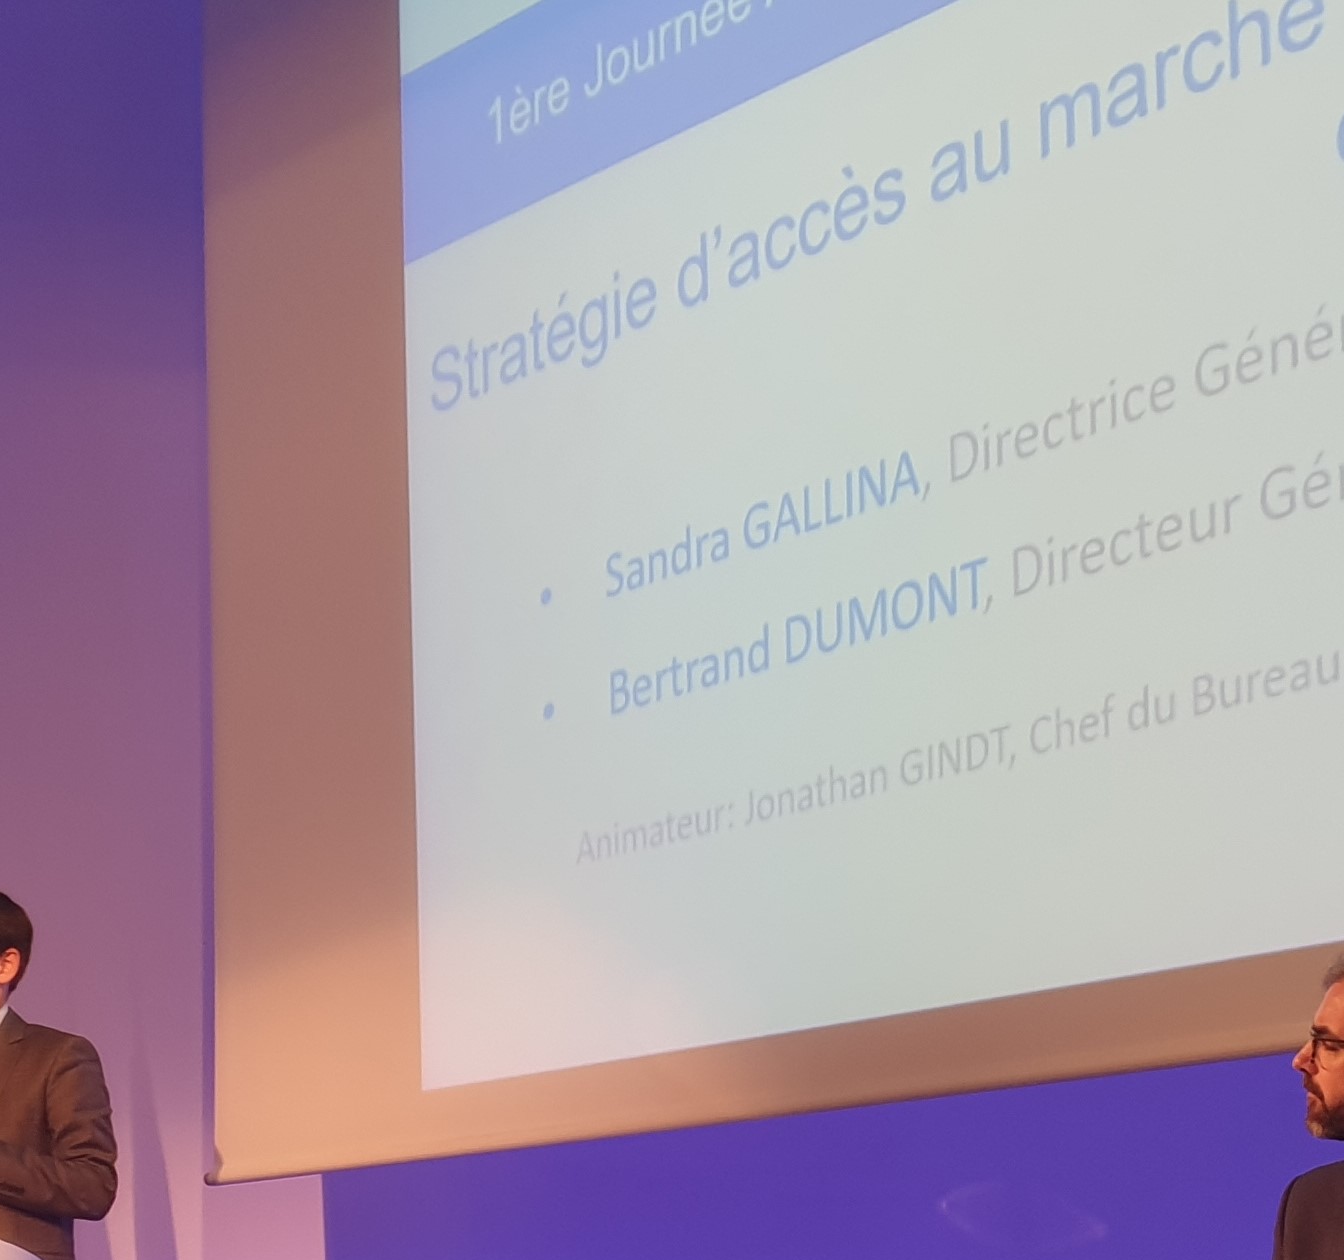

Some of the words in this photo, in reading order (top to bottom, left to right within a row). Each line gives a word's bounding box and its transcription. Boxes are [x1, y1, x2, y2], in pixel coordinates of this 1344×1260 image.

[486, 72, 571, 145] 1ère
[430, 270, 657, 412] Stratégie
[676, 164, 908, 309] d’accès
[930, 119, 1012, 201] au
[605, 525, 730, 598] Sandra
[742, 450, 931, 550] GALLINA,
[947, 373, 1178, 484] Directrice
[608, 624, 770, 716] Bertrand
[783, 556, 994, 666] DUMONT,
[1011, 491, 1244, 597] Directeur
[576, 797, 734, 864] Animateur:
[744, 761, 888, 826] Jonathan
[900, 725, 1017, 788] GINDT,
[1030, 692, 1113, 757] Chef
[1127, 684, 1177, 732] du
[1192, 649, 1340, 717] Bureau
